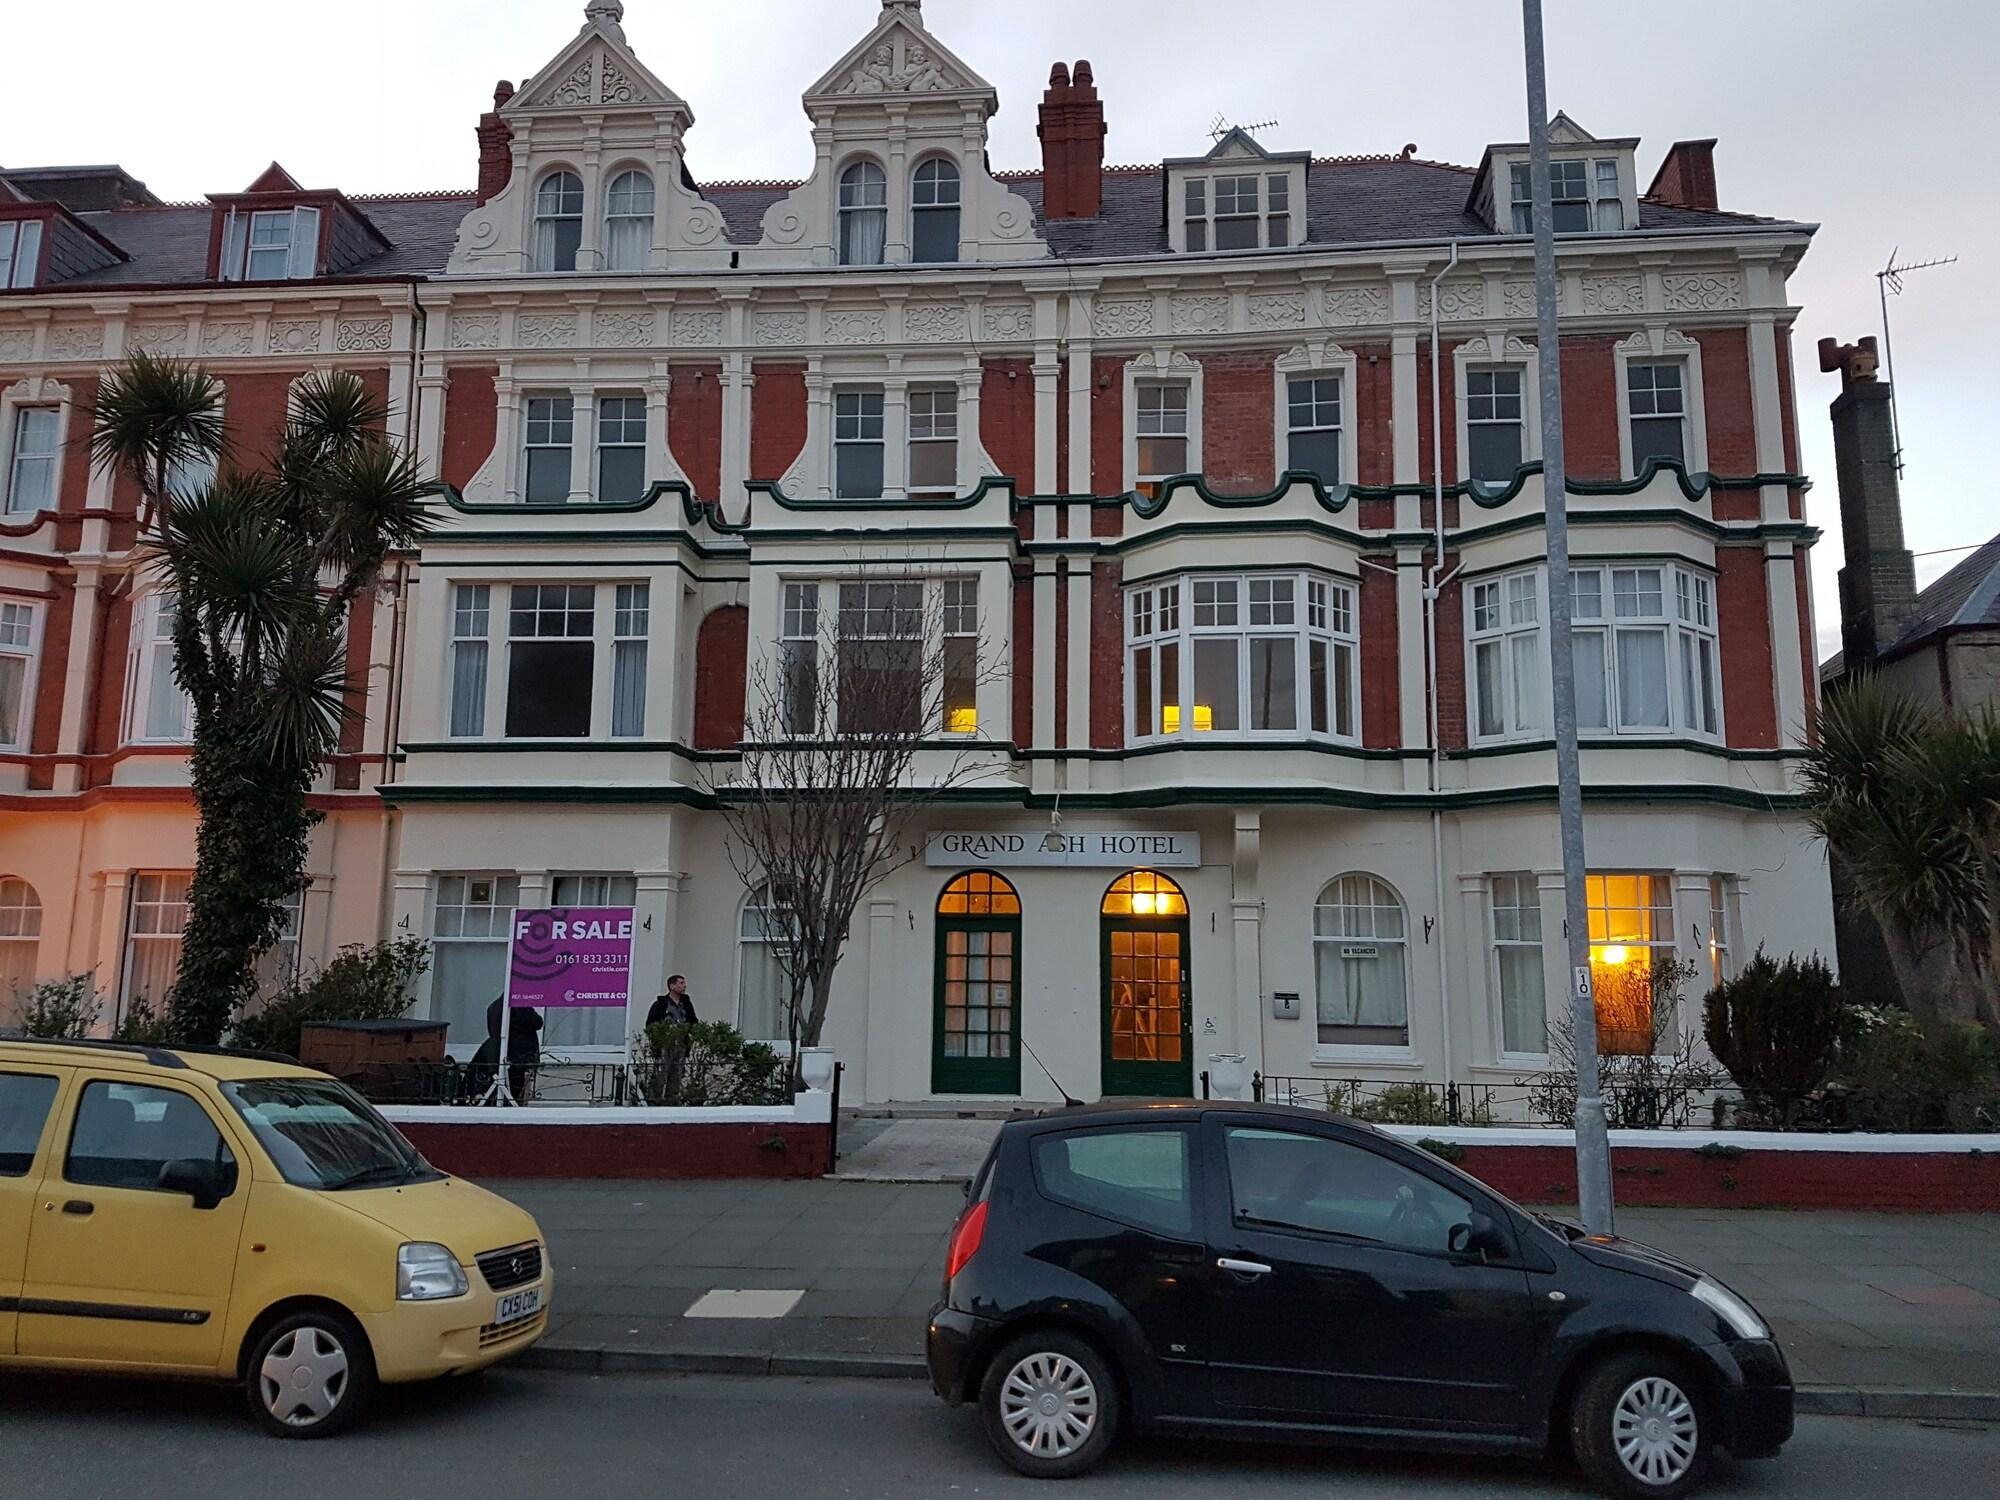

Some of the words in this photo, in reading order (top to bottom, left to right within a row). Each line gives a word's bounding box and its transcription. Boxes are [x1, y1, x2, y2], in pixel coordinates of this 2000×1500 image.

[942, 834, 1025, 860] GRAND
[1100, 836, 1183, 855] HOTEL
[516, 921, 568, 940] FOR
[572, 920, 632, 940] SALE
[555, 954, 580, 964] 0161
[583, 954, 601, 964] 833
[603, 954, 629, 964] 3311
